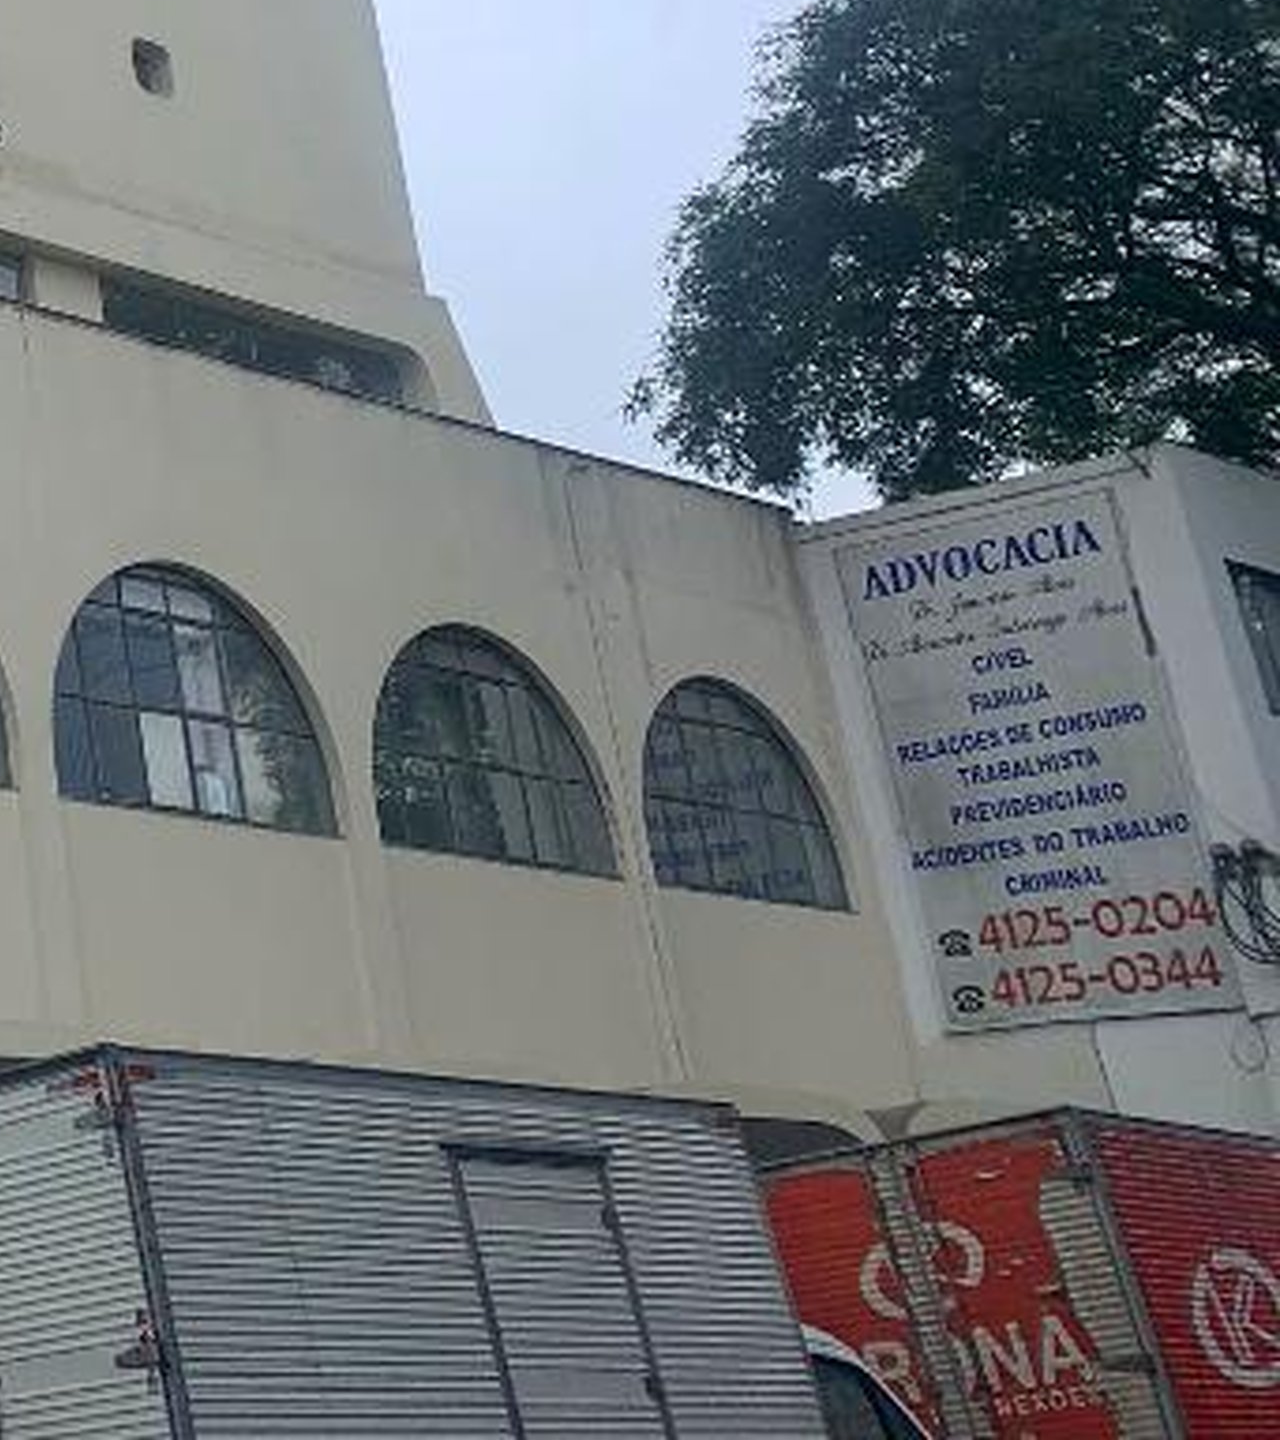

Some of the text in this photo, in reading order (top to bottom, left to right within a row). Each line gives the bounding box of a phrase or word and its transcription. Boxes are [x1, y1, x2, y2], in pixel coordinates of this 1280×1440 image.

[863, 520, 1101, 600] ADVOCACIA
[1005, 722, 1034, 746] DE
[1039, 702, 1147, 739] CONSUMO
[956, 747, 1102, 788] TRABALHISTA
[912, 812, 1191, 871] ACIDENTES DO TRABALHO
[1004, 866, 1108, 897] CRIMINAL
[978, 887, 1218, 953] 4125-0204
[991, 945, 1224, 1008] 4125-0344
